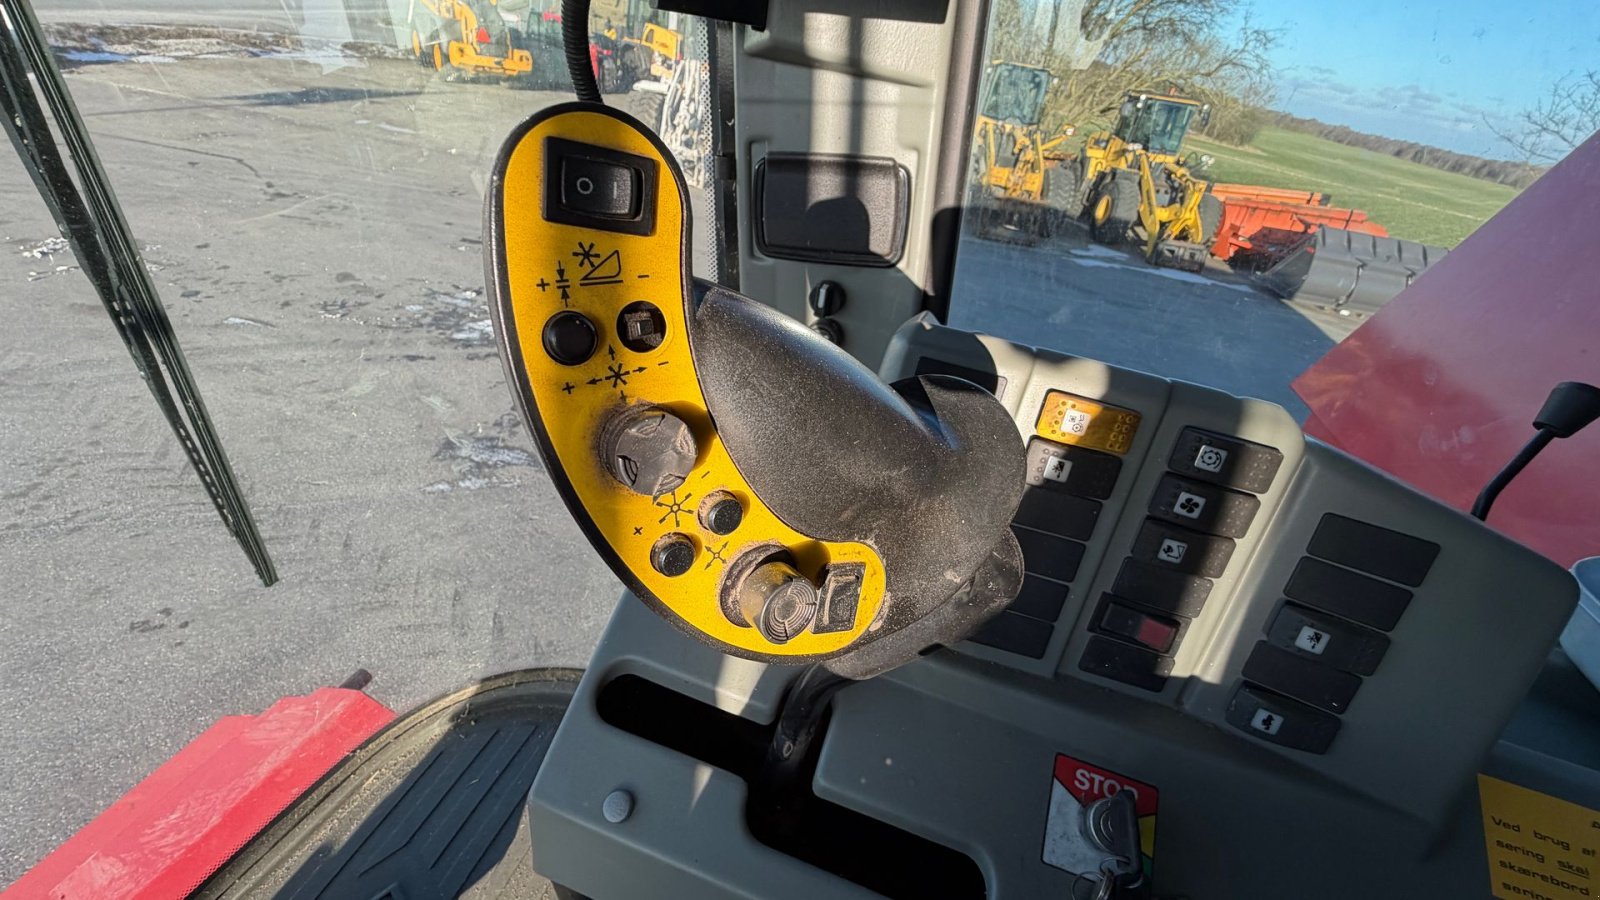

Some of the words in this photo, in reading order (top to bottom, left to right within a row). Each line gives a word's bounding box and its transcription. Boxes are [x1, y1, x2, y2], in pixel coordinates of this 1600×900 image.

[1491, 816, 1521, 832] Ved
[1533, 829, 1570, 851] brug
[1496, 840, 1545, 863] sering
[1557, 860, 1590, 877] skal
[1499, 860, 1590, 896] skærebord
[1502, 881, 1553, 900] serin
